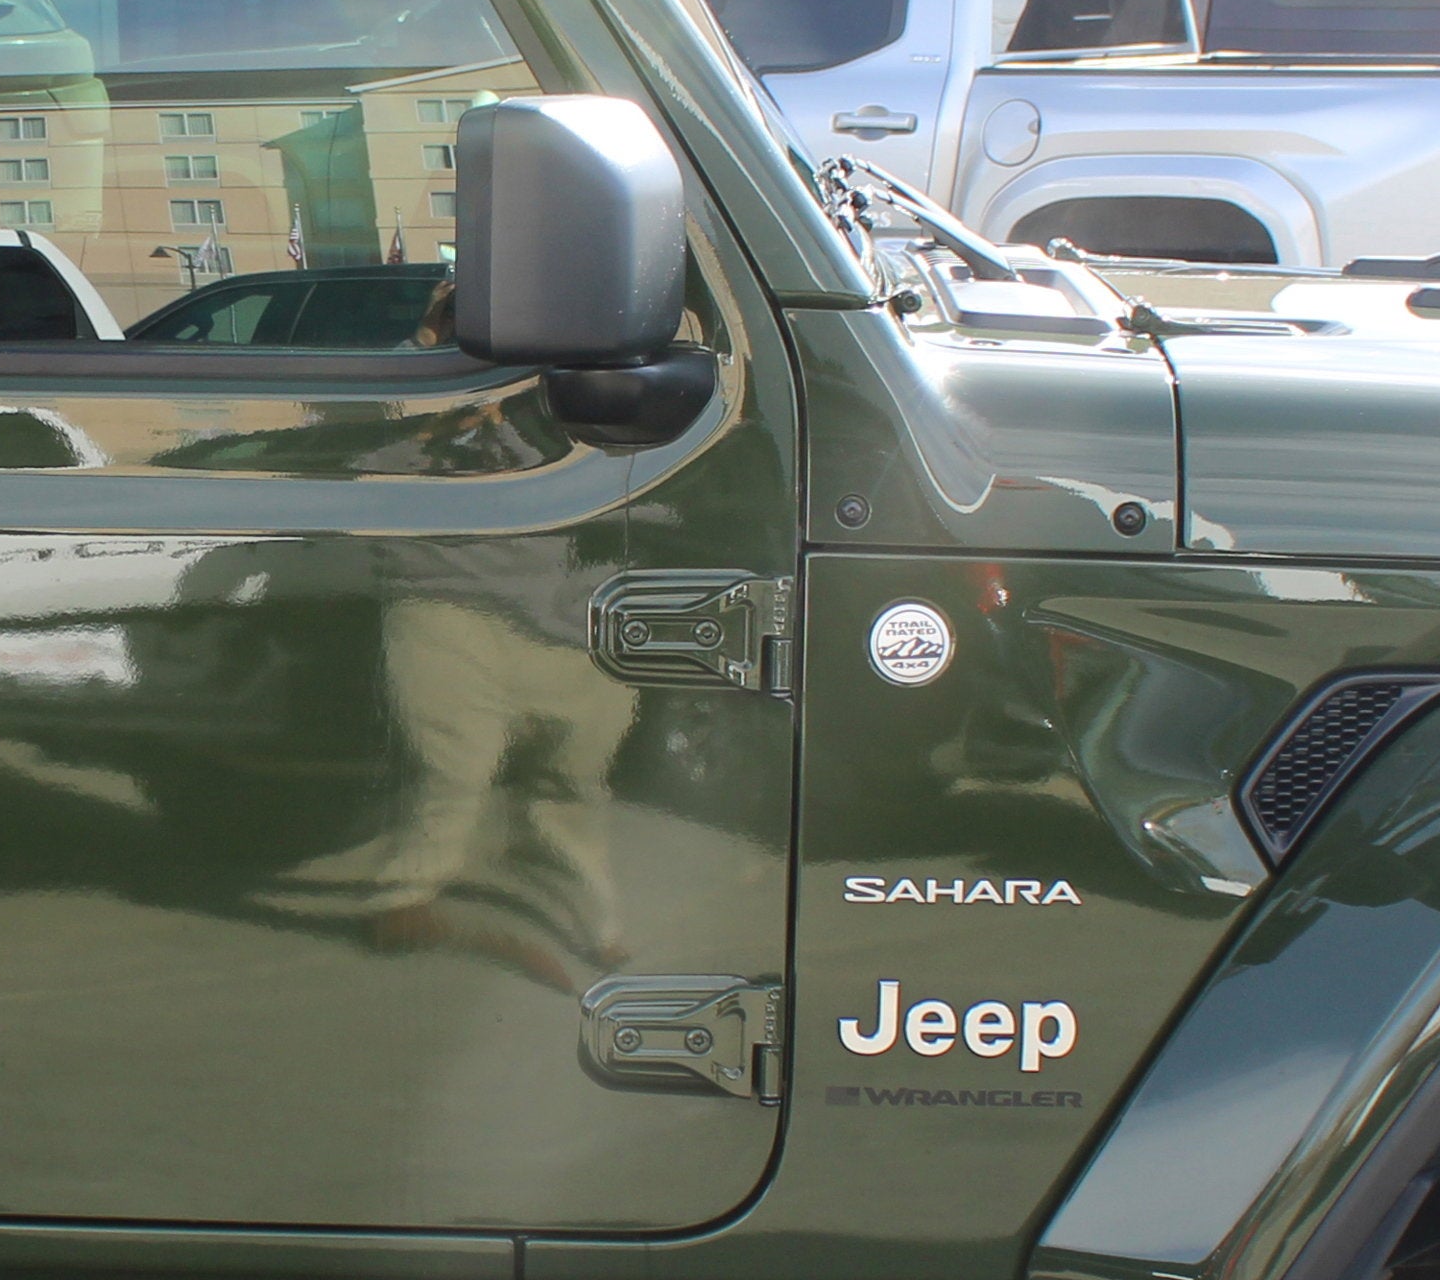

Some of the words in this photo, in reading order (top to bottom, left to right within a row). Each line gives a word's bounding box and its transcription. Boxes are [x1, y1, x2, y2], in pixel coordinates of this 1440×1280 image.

[885, 628, 937, 636] RATED
[888, 621, 933, 629] TRAIL
[843, 876, 1083, 906] SAHARA
[837, 979, 1079, 1073] Jeep
[864, 1086, 1083, 1110] WRANGLER
